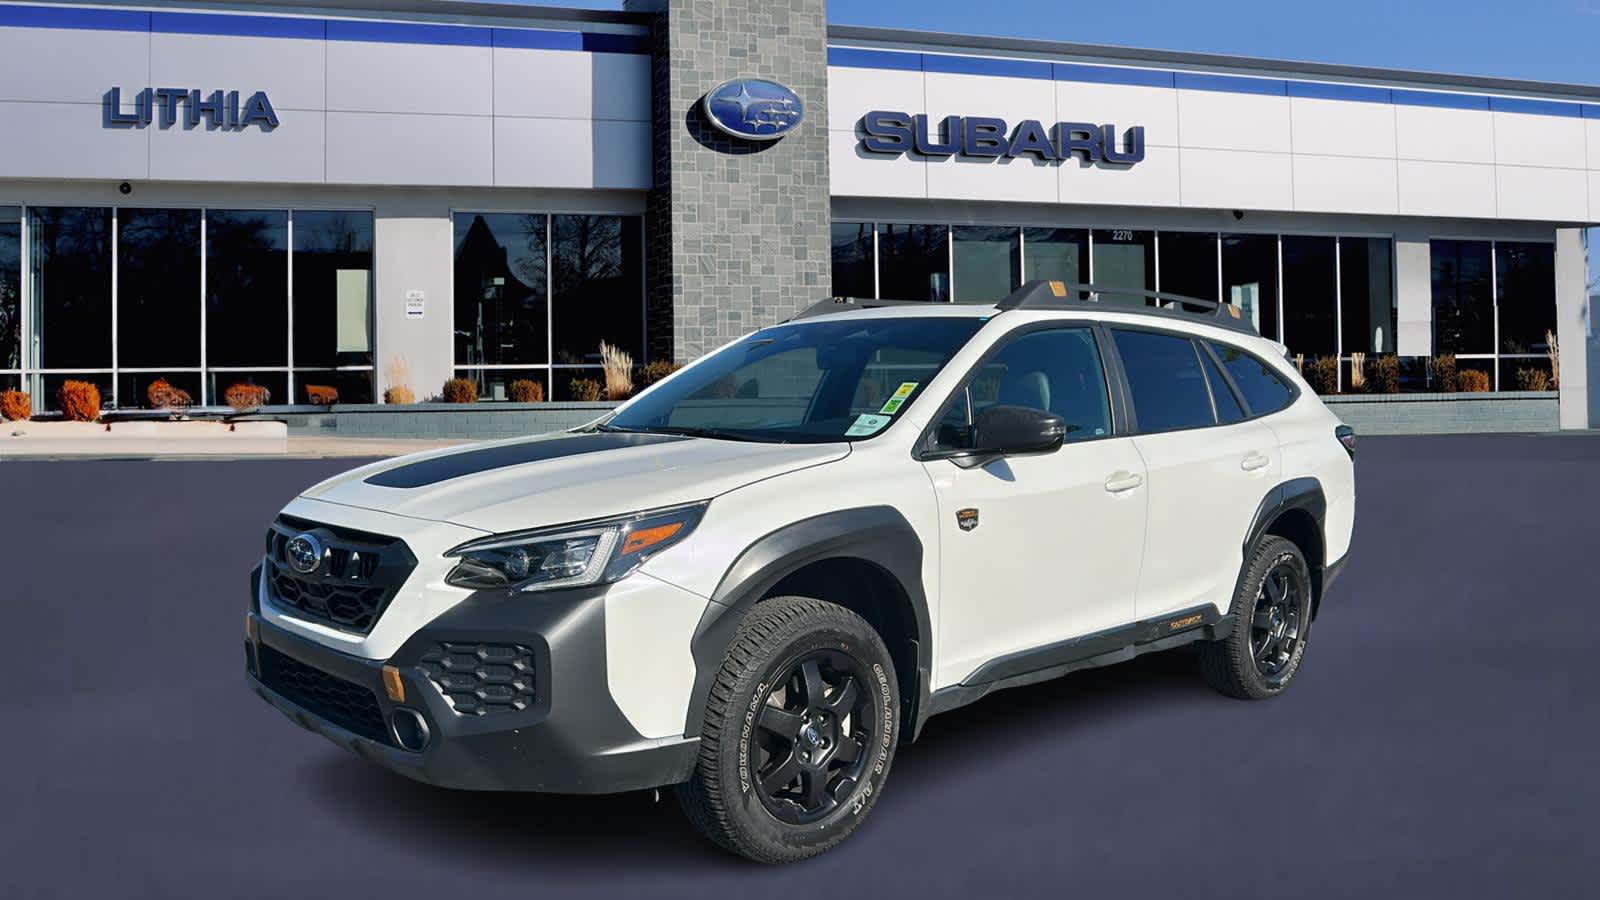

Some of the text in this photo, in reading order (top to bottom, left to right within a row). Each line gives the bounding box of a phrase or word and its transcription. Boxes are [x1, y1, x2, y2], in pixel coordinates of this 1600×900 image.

[109, 86, 279, 129] LITHIA
[860, 110, 1146, 165] SUBARU
[1112, 230, 1133, 241] 2270
[739, 682, 769, 793] YOKOHAMA
